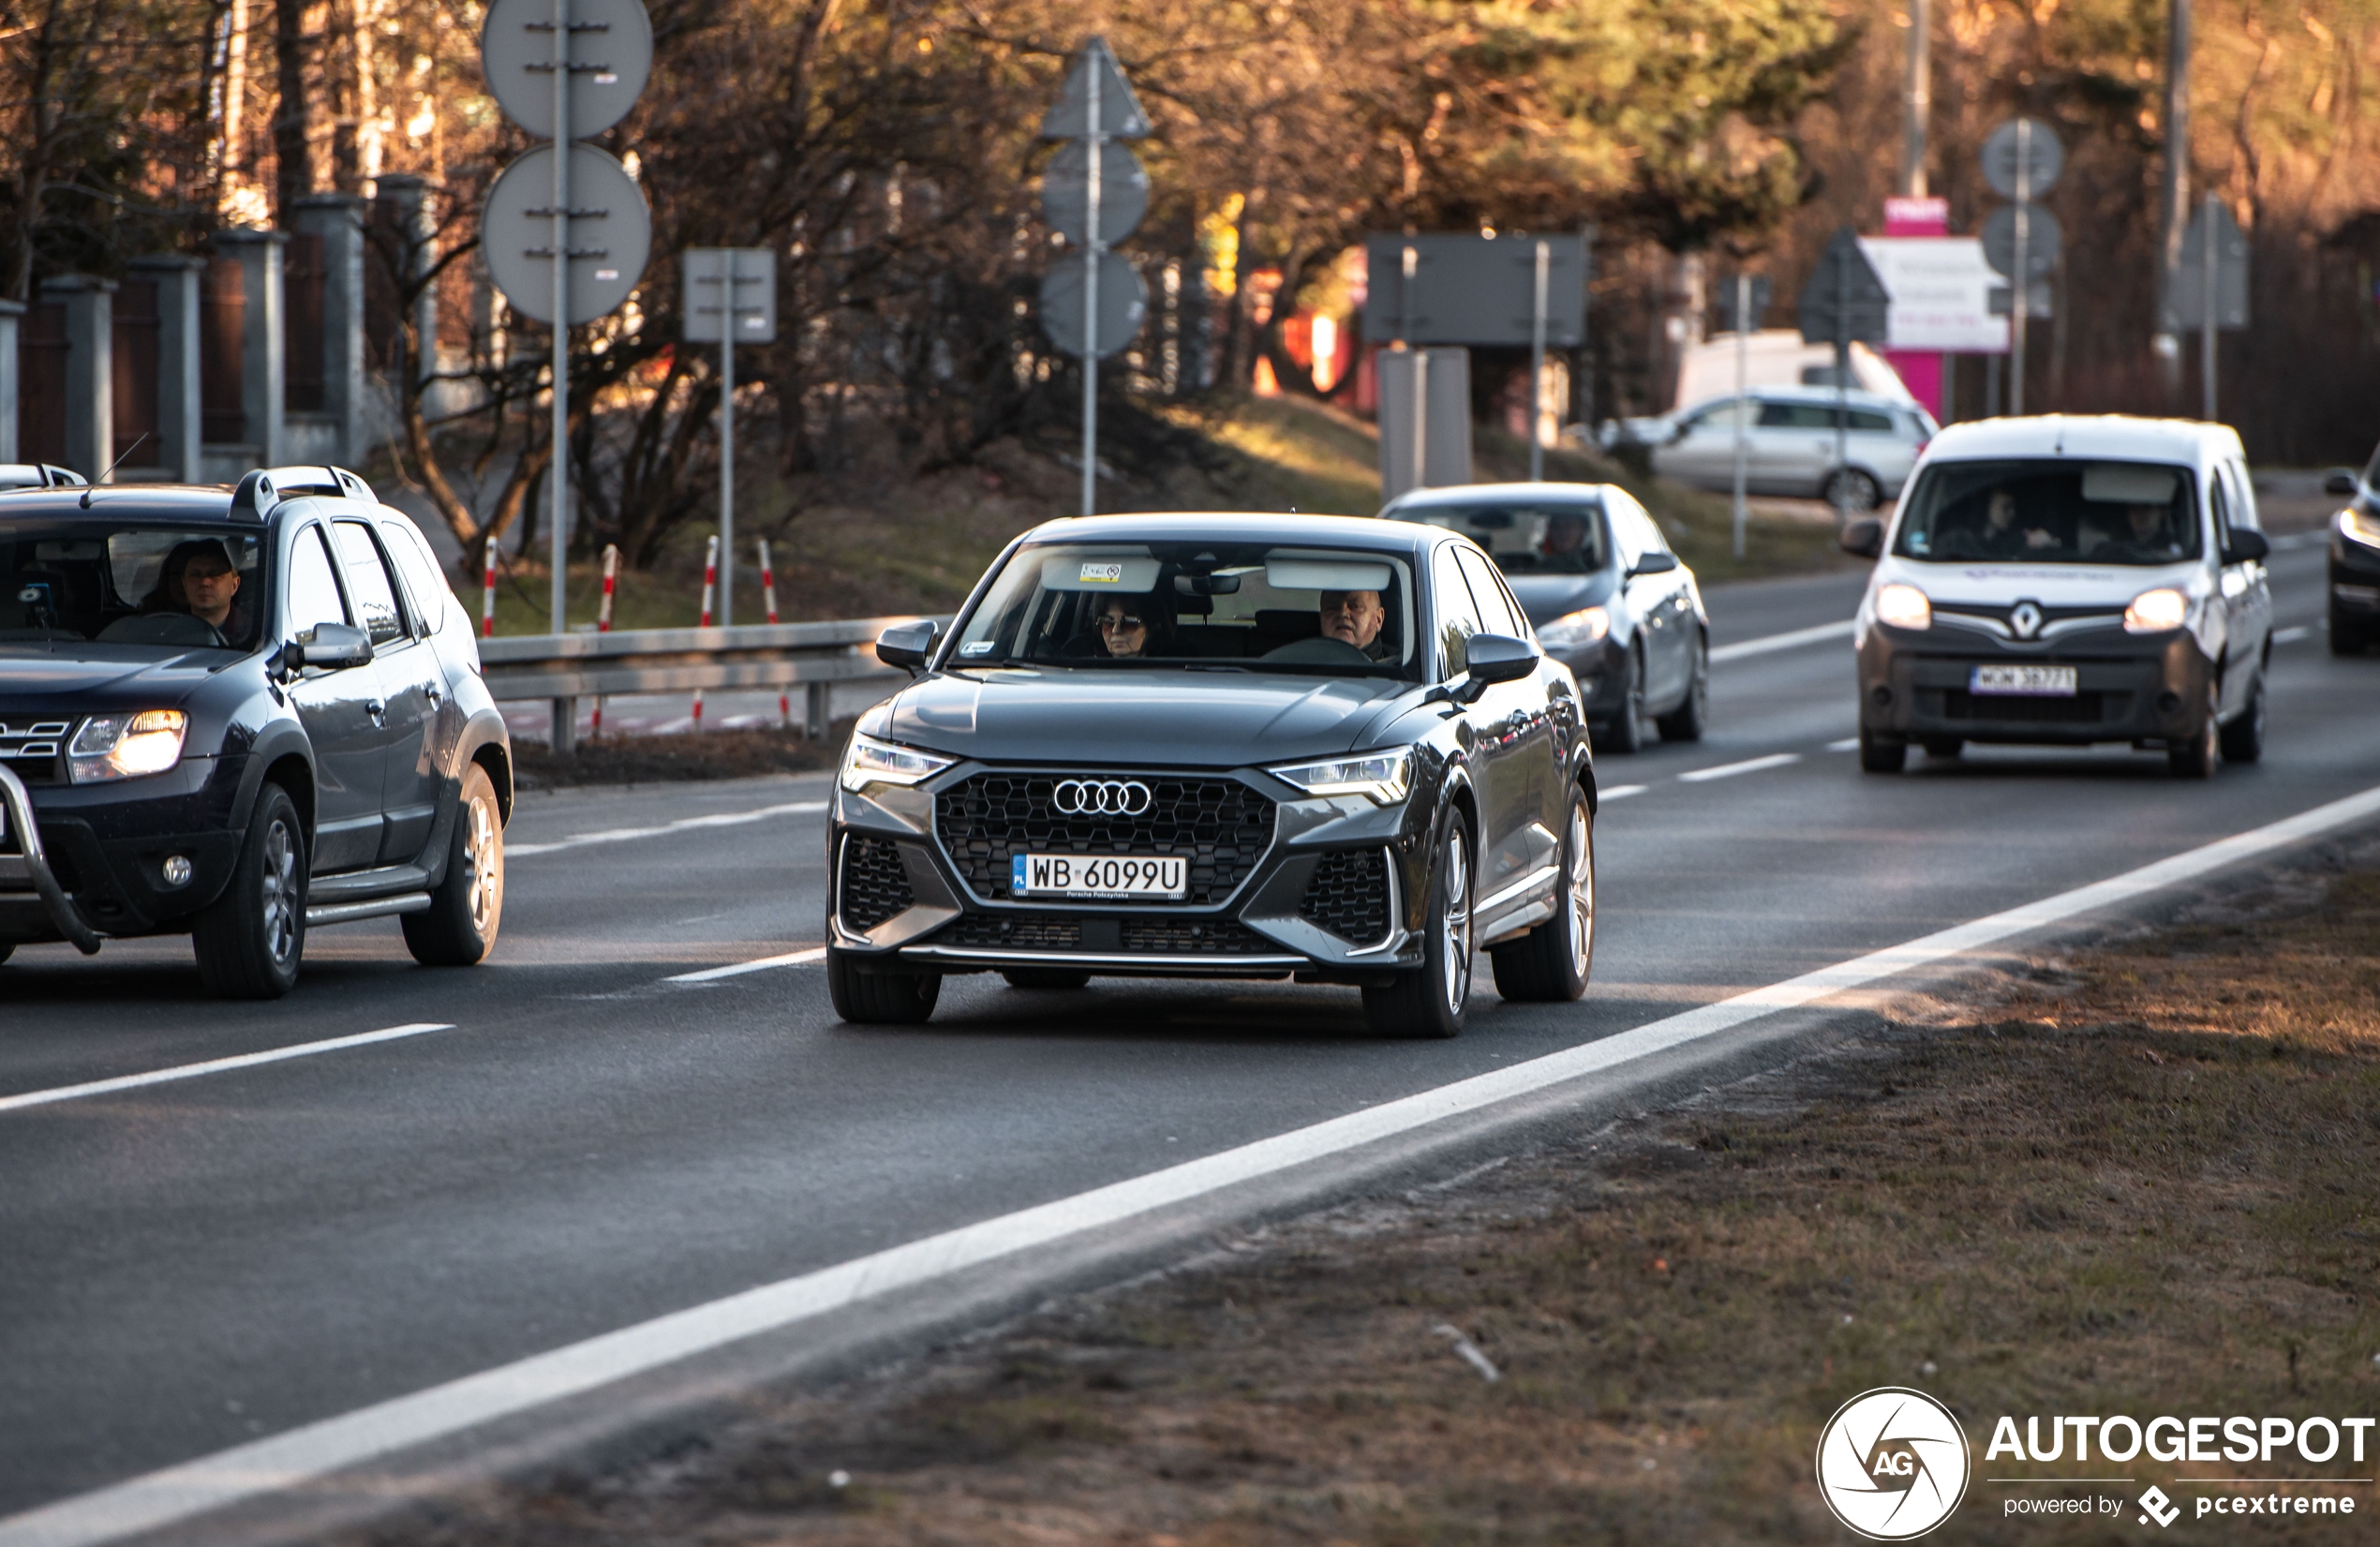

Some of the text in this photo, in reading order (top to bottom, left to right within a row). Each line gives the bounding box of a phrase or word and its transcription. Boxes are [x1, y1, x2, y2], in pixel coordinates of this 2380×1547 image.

[1034, 858, 1180, 889] WB 6099U
[1014, 874, 1024, 885] PL
[1066, 890, 1092, 899] Porsche
